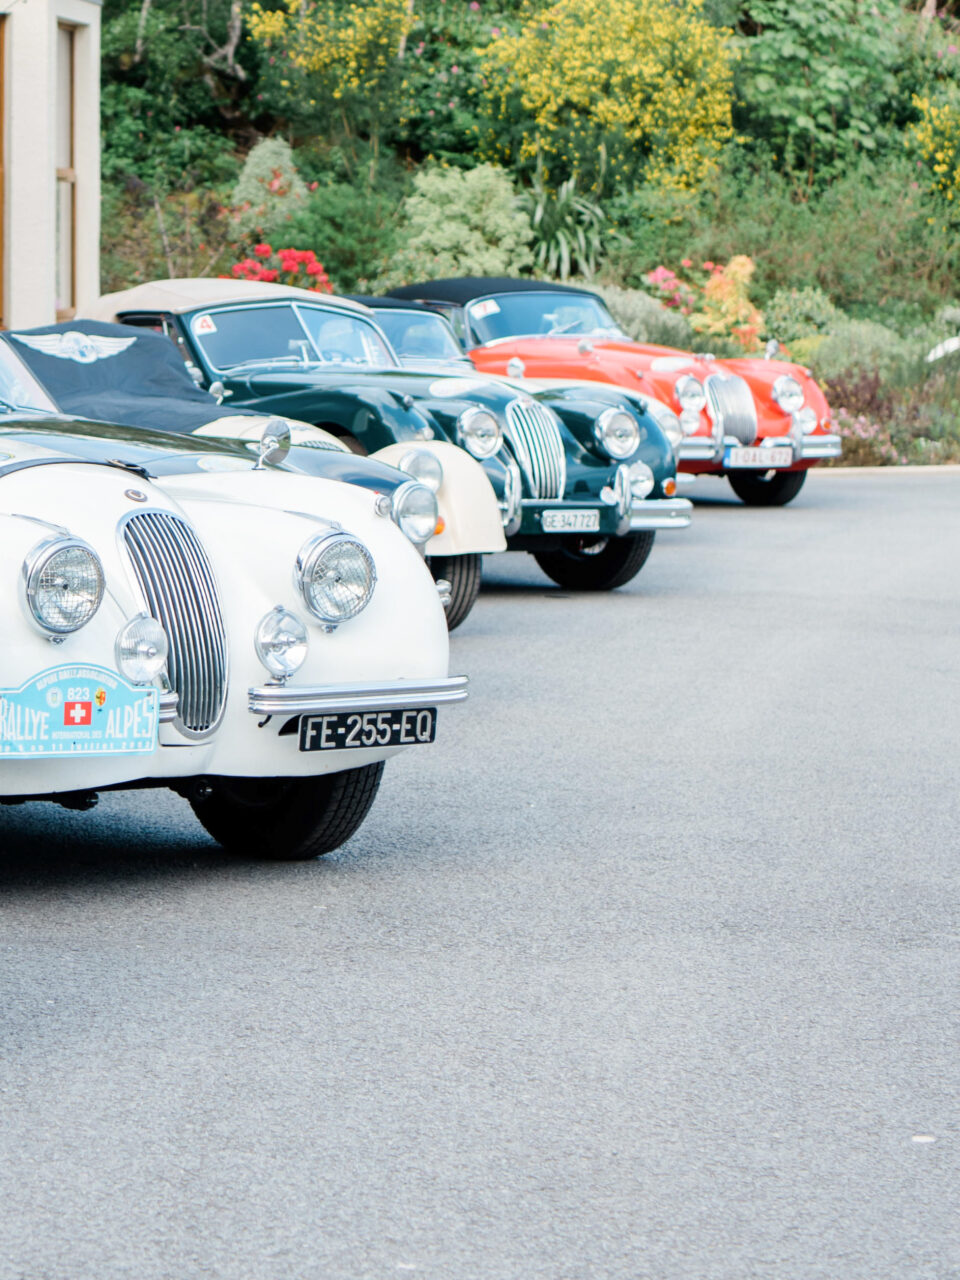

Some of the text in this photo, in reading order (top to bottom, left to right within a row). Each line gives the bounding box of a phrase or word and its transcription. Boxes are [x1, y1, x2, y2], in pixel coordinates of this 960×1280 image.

[67, 687, 90, 700] 823
[105, 694, 154, 738] ALPES
[305, 710, 432, 750] FE-255-EQ
